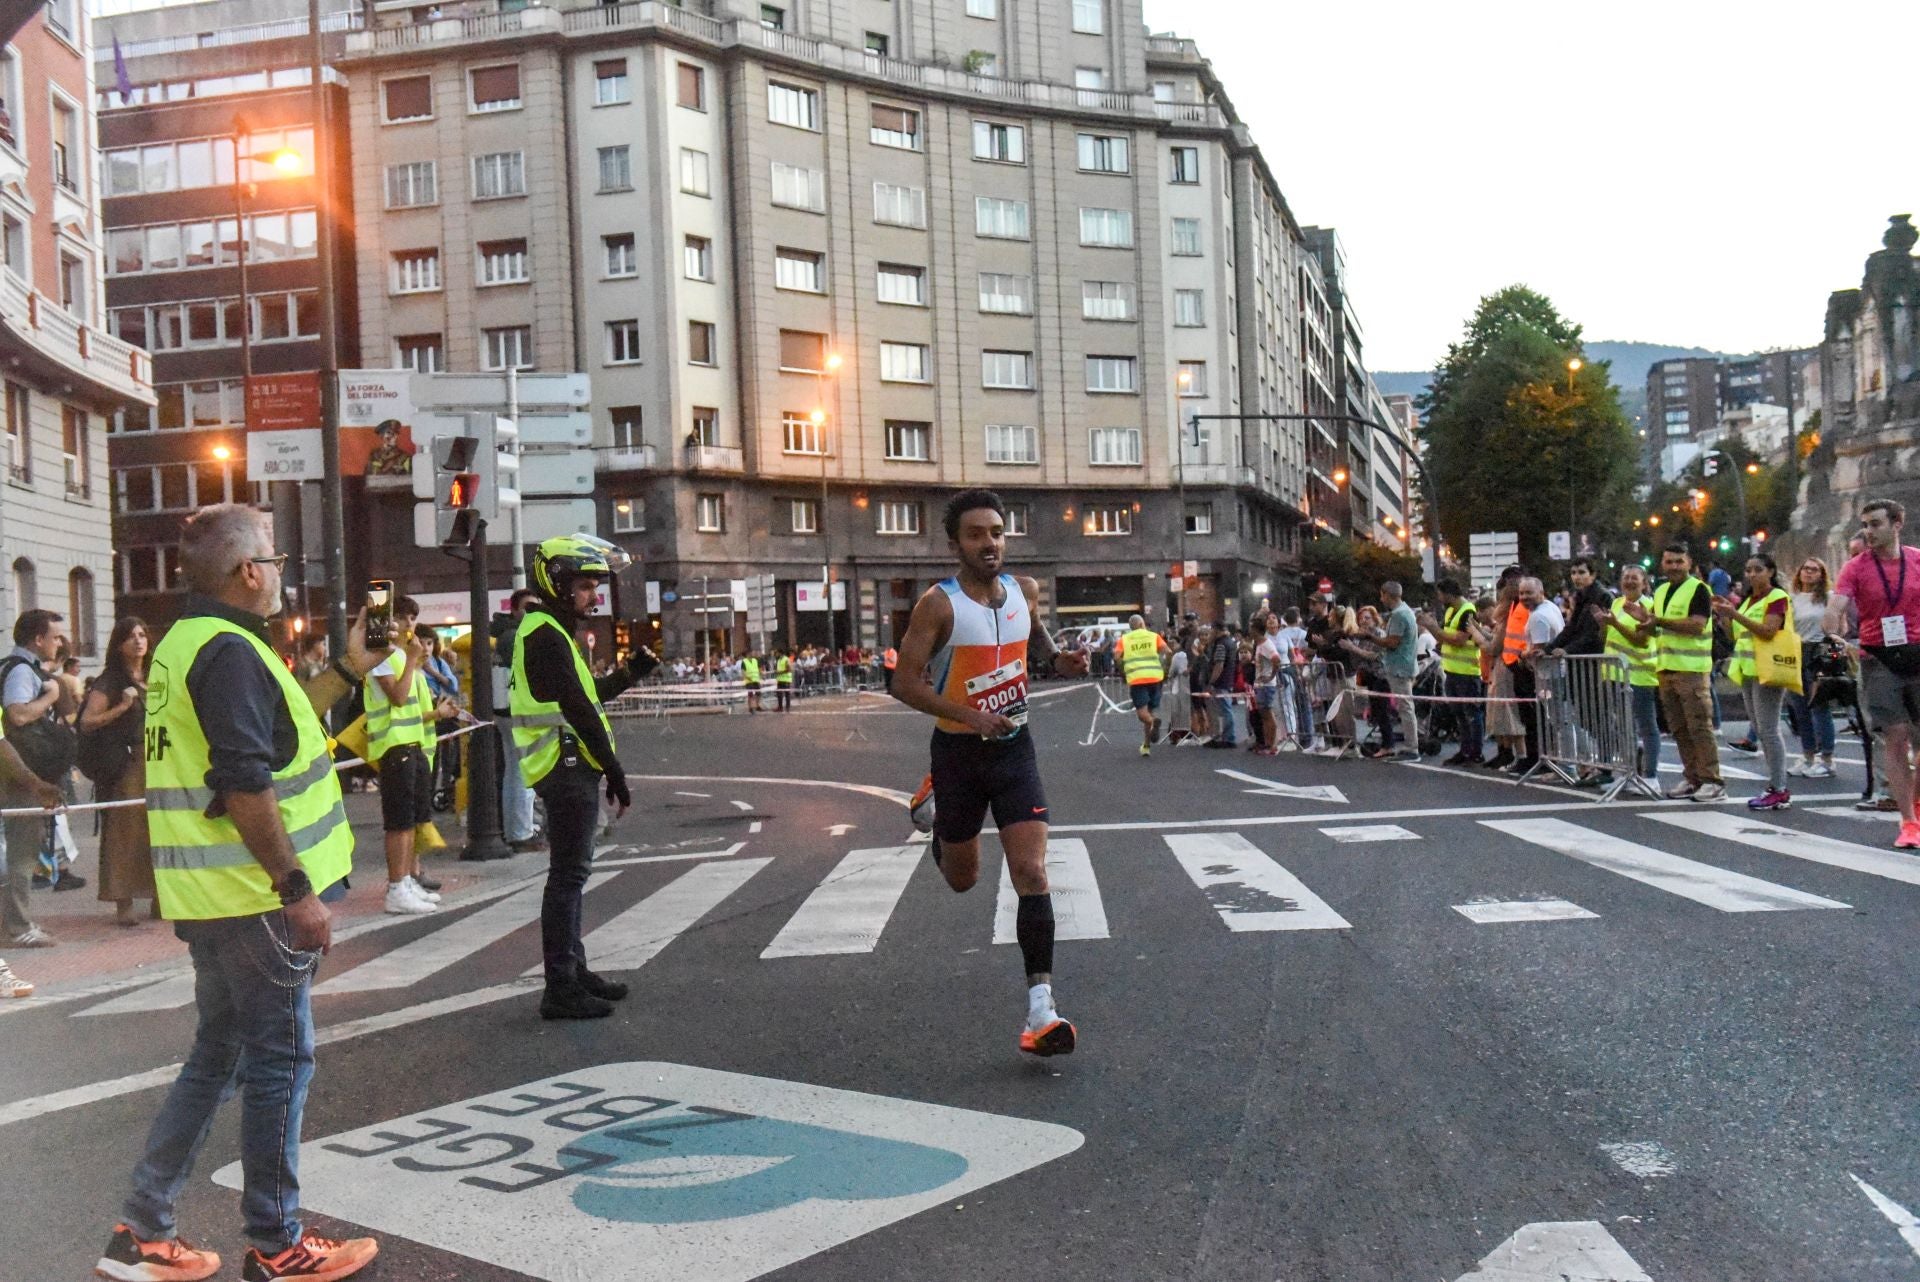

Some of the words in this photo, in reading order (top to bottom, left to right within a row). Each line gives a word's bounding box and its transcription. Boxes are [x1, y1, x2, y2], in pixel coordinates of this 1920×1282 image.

[362, 391, 398, 399] DESTINO
[1131, 642, 1152, 651] STAFF
[977, 681, 1027, 713] 20001
[466, 1082, 758, 1147] ZBE
